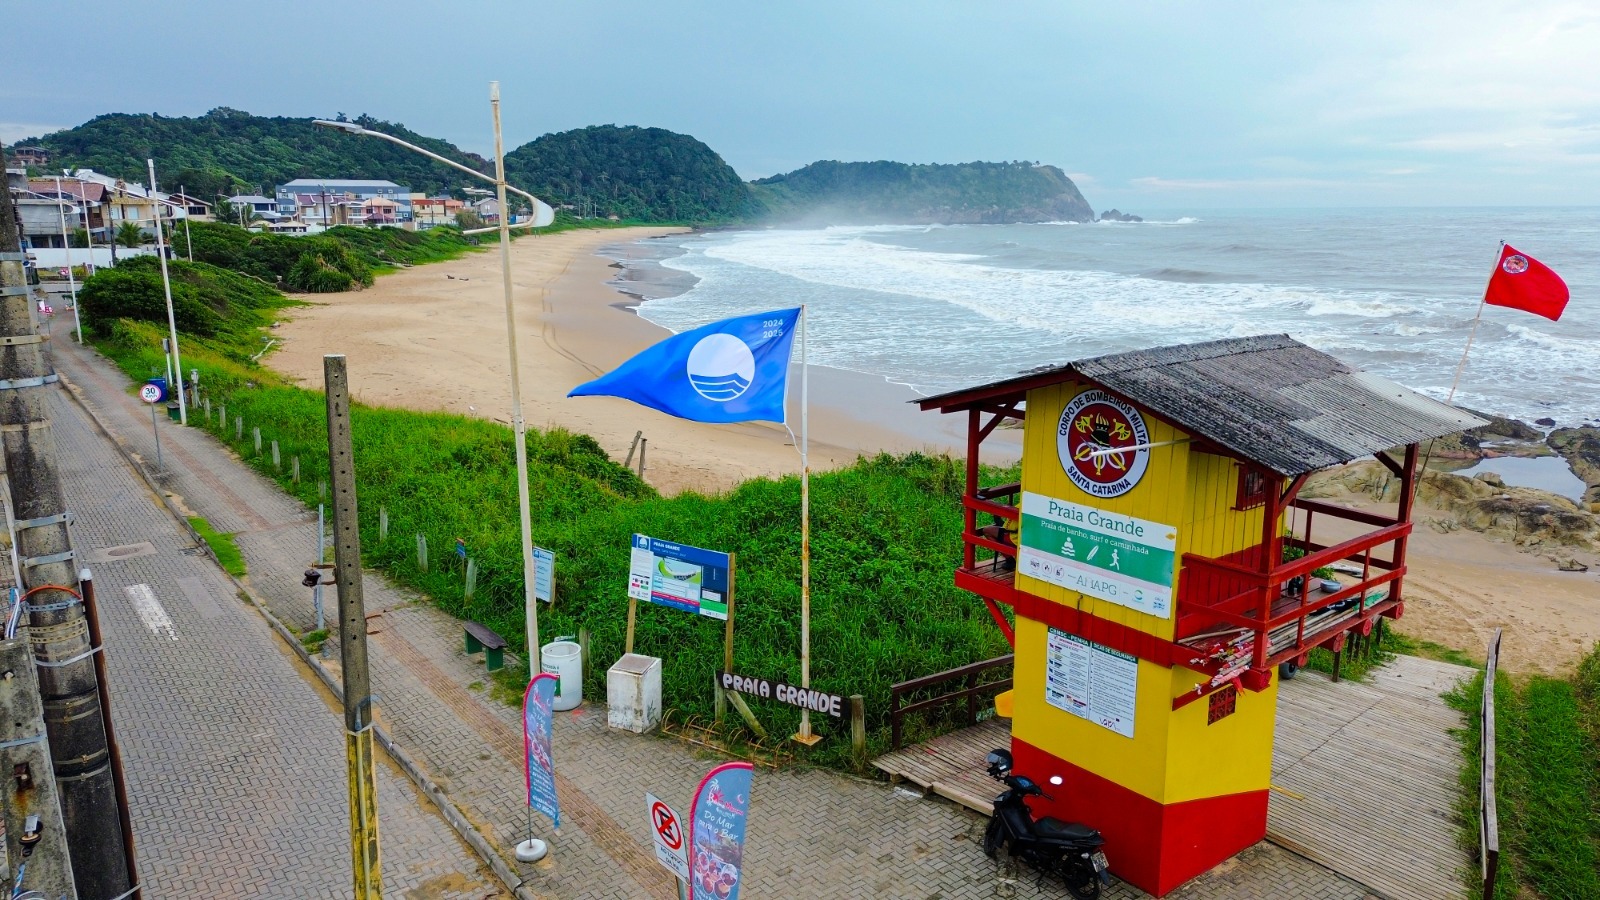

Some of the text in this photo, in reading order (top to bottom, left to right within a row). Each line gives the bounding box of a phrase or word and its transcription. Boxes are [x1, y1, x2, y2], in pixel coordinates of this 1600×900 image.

[763, 319, 783, 328] 2024
[763, 329, 783, 338] 2025
[1059, 406, 1075, 436] CORPO
[1073, 397, 1085, 408] DE
[1084, 391, 1133, 415] BOMBEIROS
[1067, 465, 1132, 495] SANTA CATARINA
[1048, 500, 1144, 537] Praia Grande
[1041, 520, 1057, 531] Praia
[1057, 525, 1066, 533] de
[1066, 527, 1089, 539] banho,
[1089, 534, 1104, 543] surf
[1109, 538, 1149, 555] caminhada
[722, 673, 841, 718] PRAIA GRANDE
[698, 819, 713, 831] para
[720, 828, 739, 840] Bar
[704, 810, 715, 821] Do
[716, 816, 735, 830] Mar
